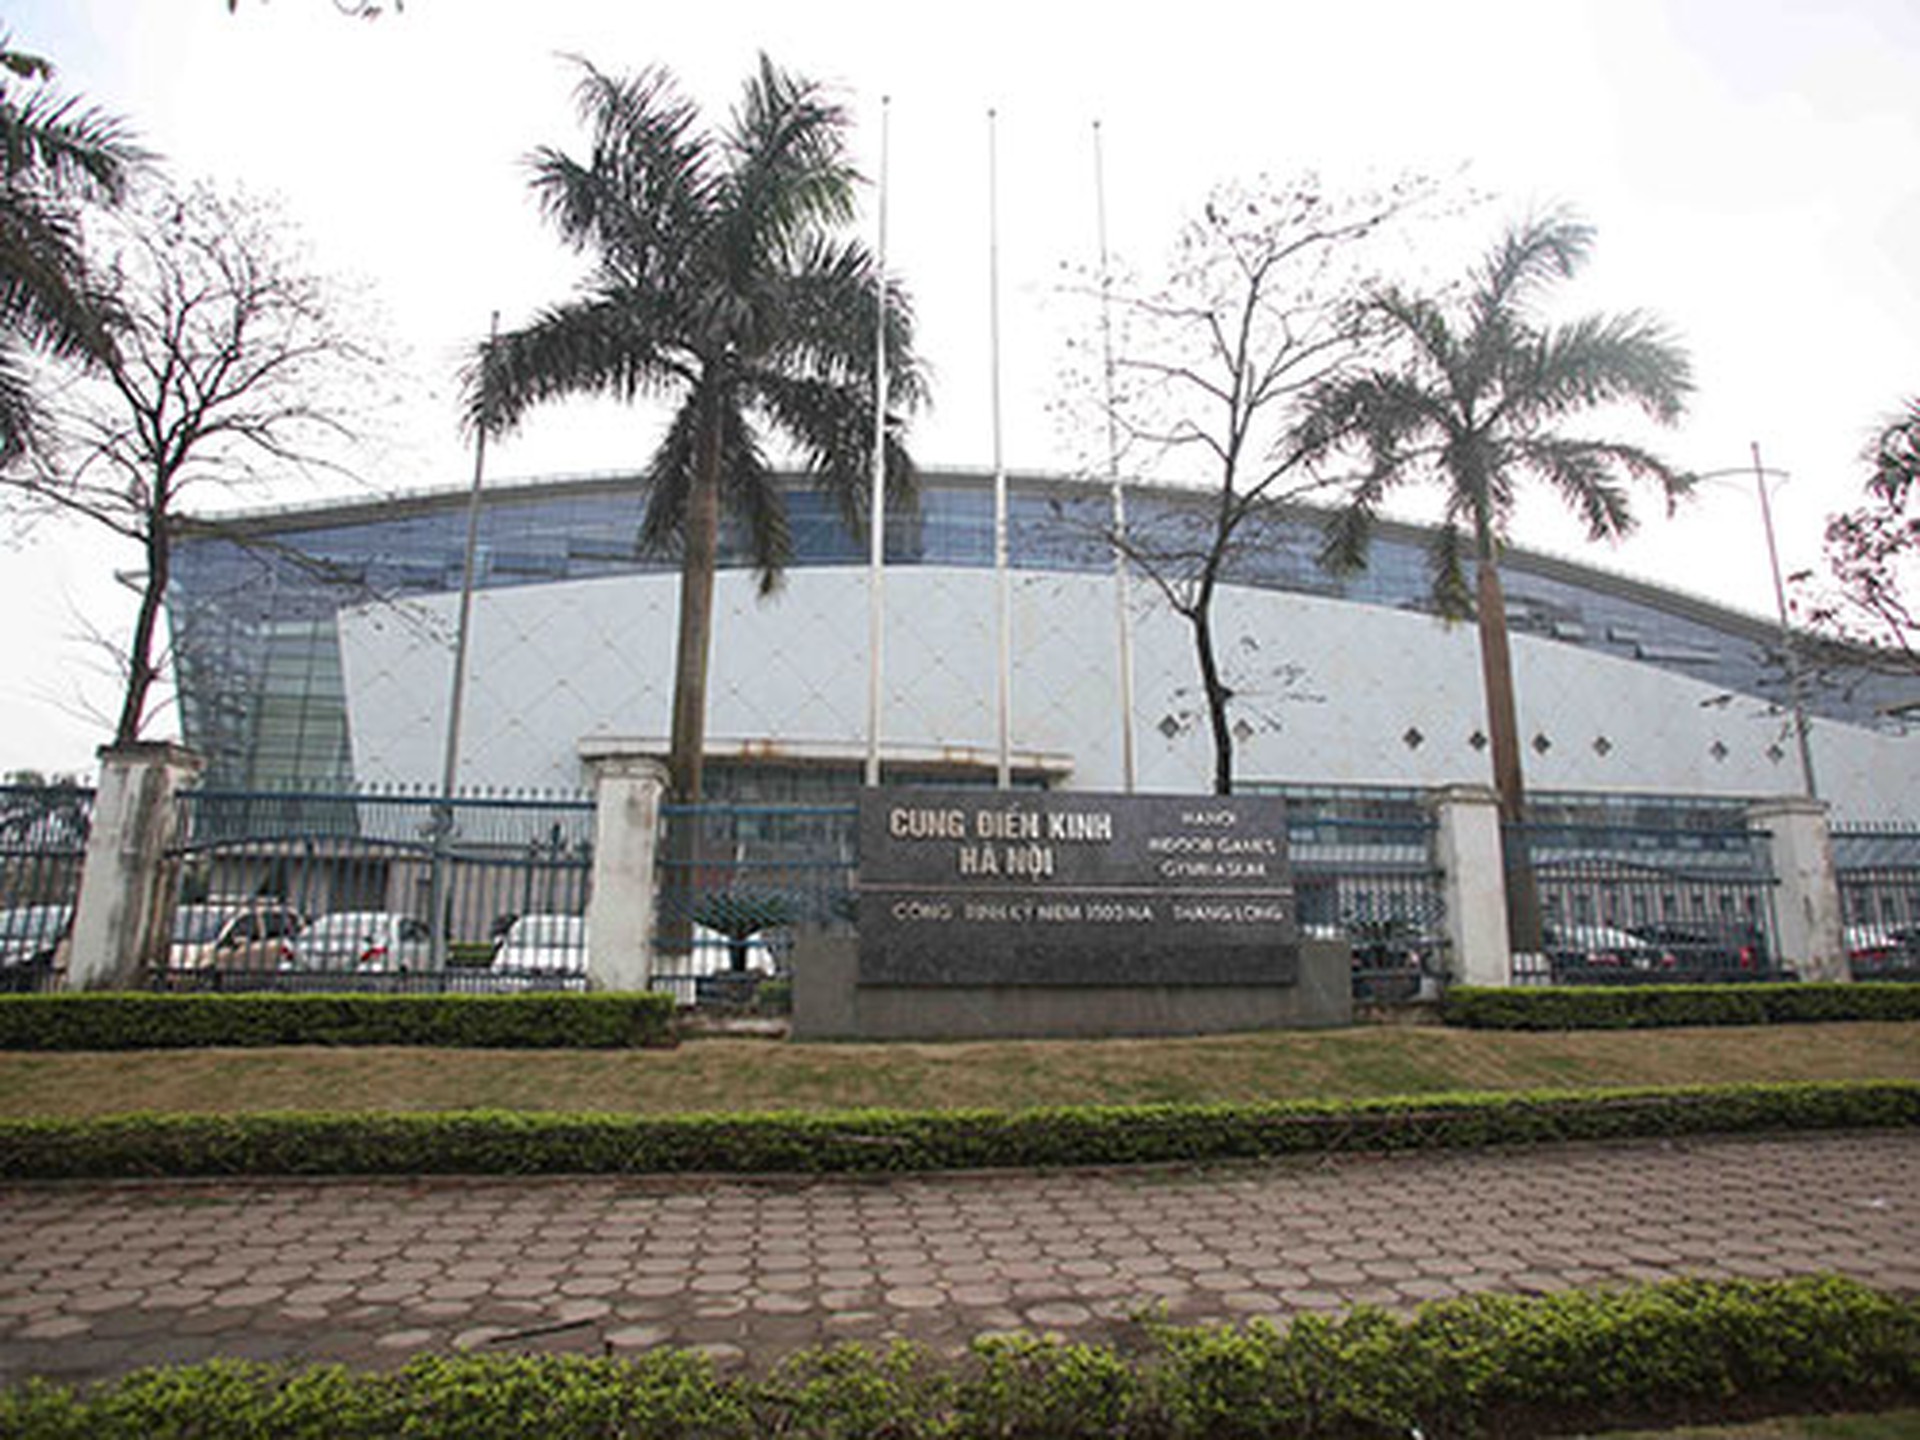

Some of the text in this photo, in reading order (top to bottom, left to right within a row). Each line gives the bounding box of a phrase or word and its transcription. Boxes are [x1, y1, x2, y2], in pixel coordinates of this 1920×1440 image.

[890, 808, 965, 838] CUNG
[1048, 811, 1112, 839] KINH
[960, 842, 1054, 882] HÀ NỘI
